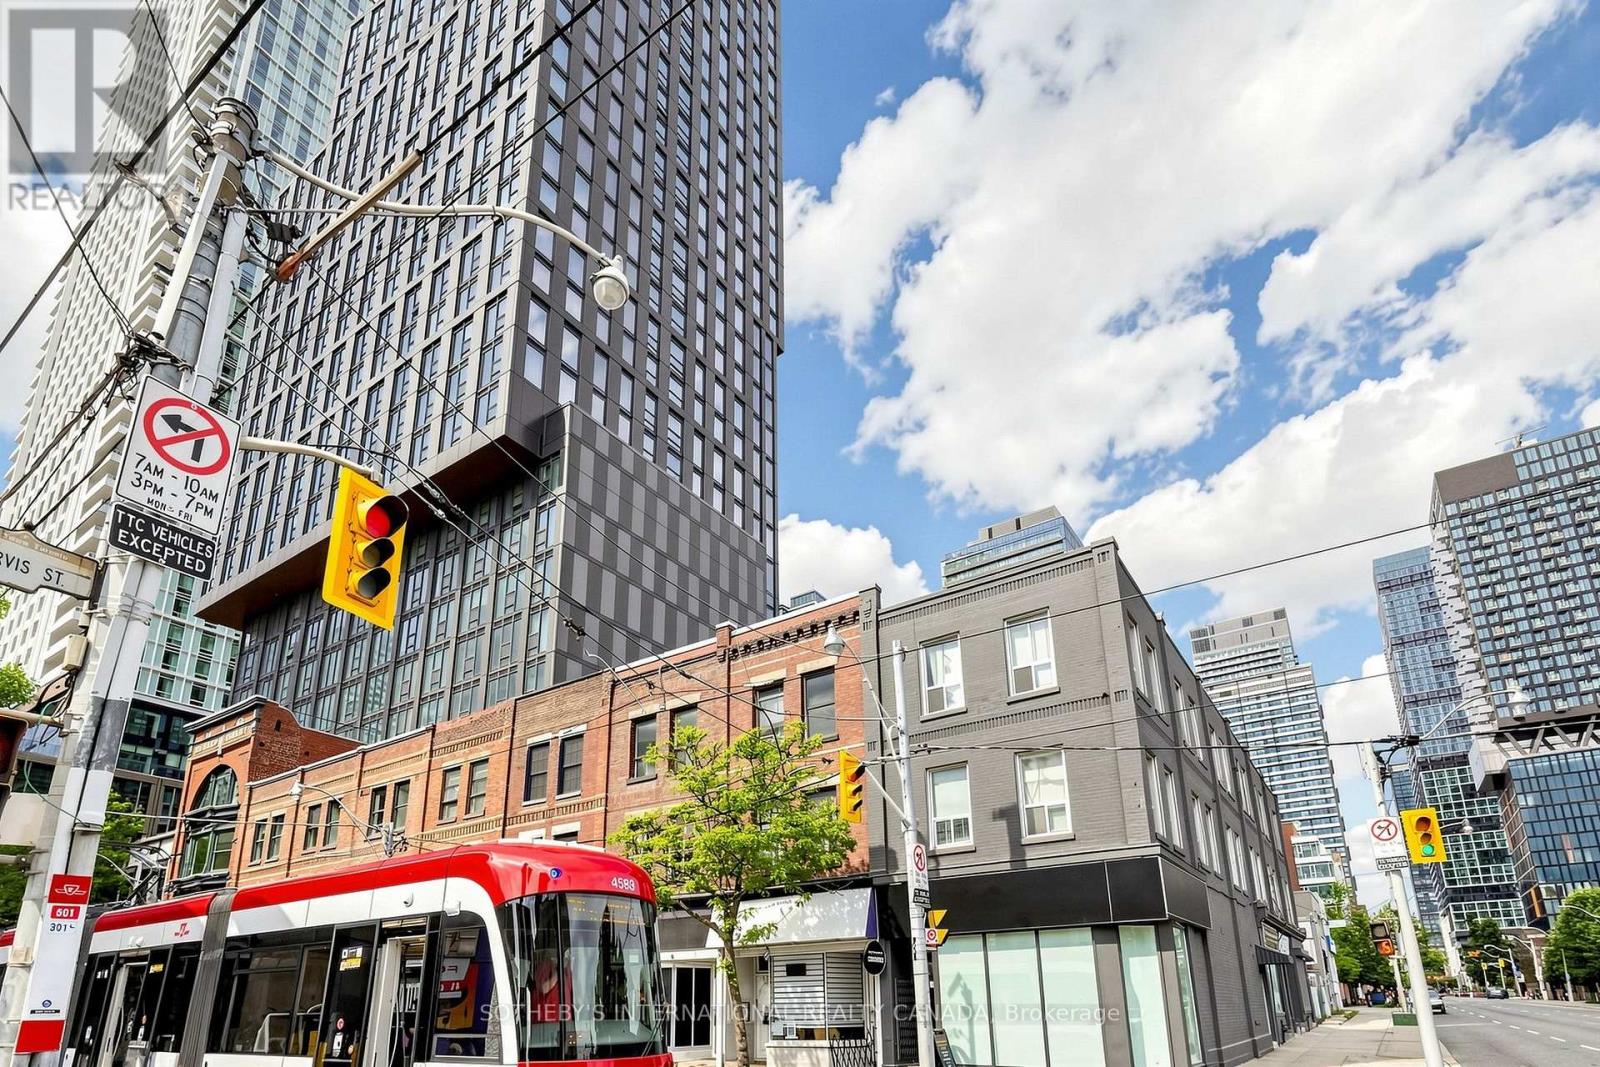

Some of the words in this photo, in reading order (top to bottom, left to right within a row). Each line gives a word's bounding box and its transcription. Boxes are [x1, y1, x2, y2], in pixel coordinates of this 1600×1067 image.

[130, 471, 164, 497] 3PM
[185, 493, 215, 519] 7PM
[135, 452, 164, 479] 7AM
[184, 475, 219, 503] 10AM
[116, 509, 146, 532] TTC
[151, 523, 213, 558] VEHICLES
[178, 509, 193, 522] FRI
[117, 528, 206, 573] EXCEPTED
[43, 567, 65, 587] ST.
[49, 922, 67, 932] 301
